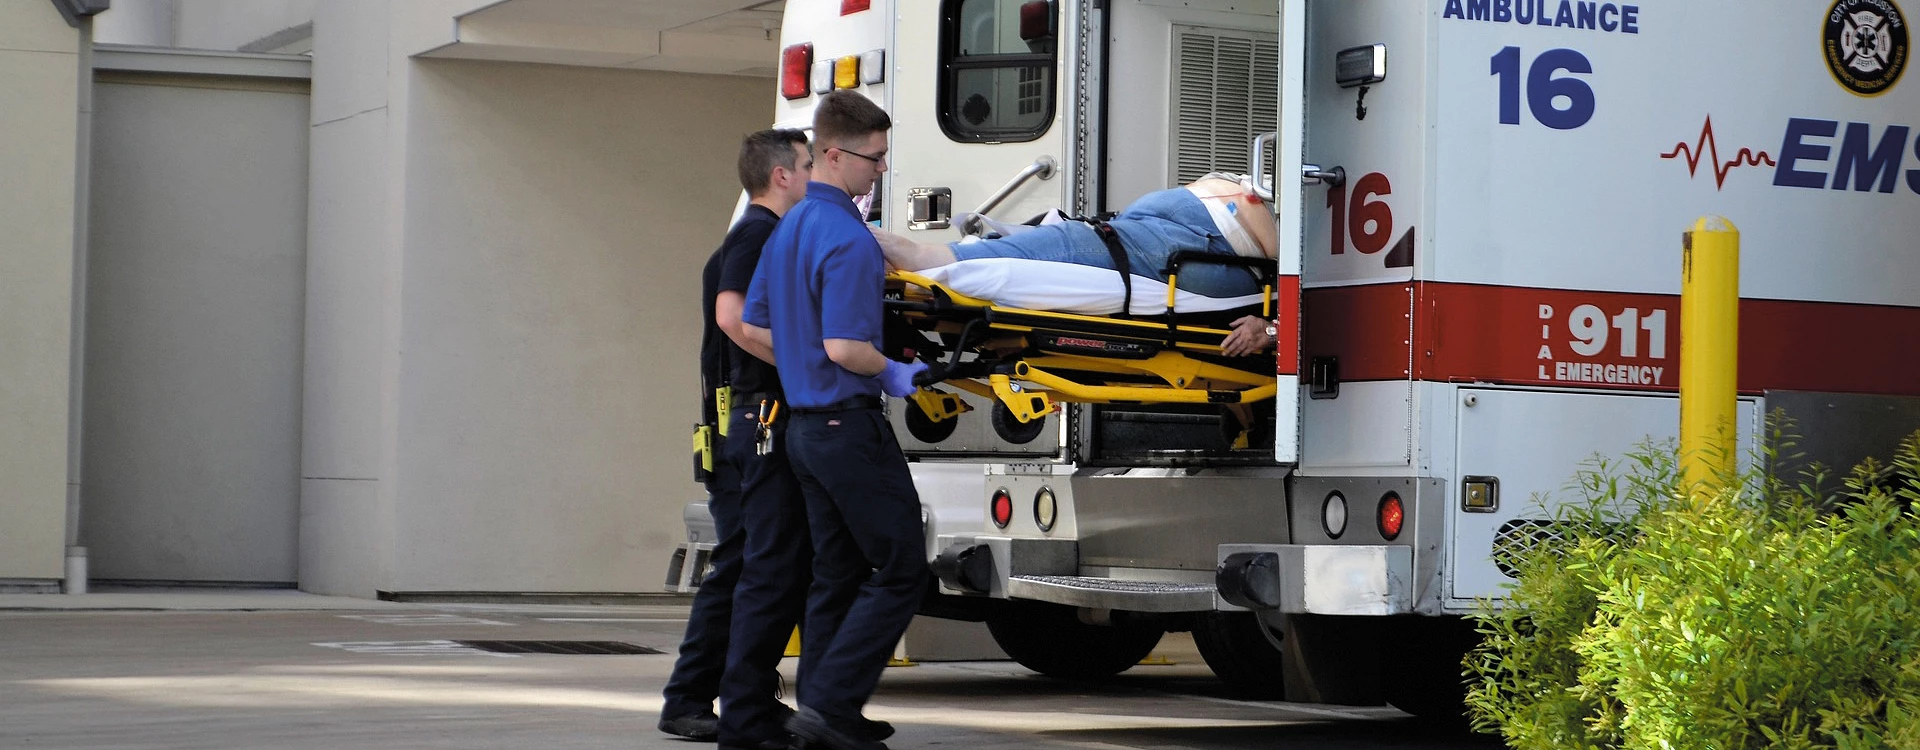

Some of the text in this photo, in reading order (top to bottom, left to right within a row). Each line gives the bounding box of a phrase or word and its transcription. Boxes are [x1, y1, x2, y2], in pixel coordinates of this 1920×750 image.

[1443, 0, 1639, 34] AMBULANCE
[1490, 45, 1596, 130] 16
[1772, 117, 1920, 196] EM
[1326, 171, 1393, 255] 16
[1537, 304, 1554, 380] DIAL
[1568, 304, 1667, 359] 911
[1555, 361, 1664, 385] EMERGENCY
